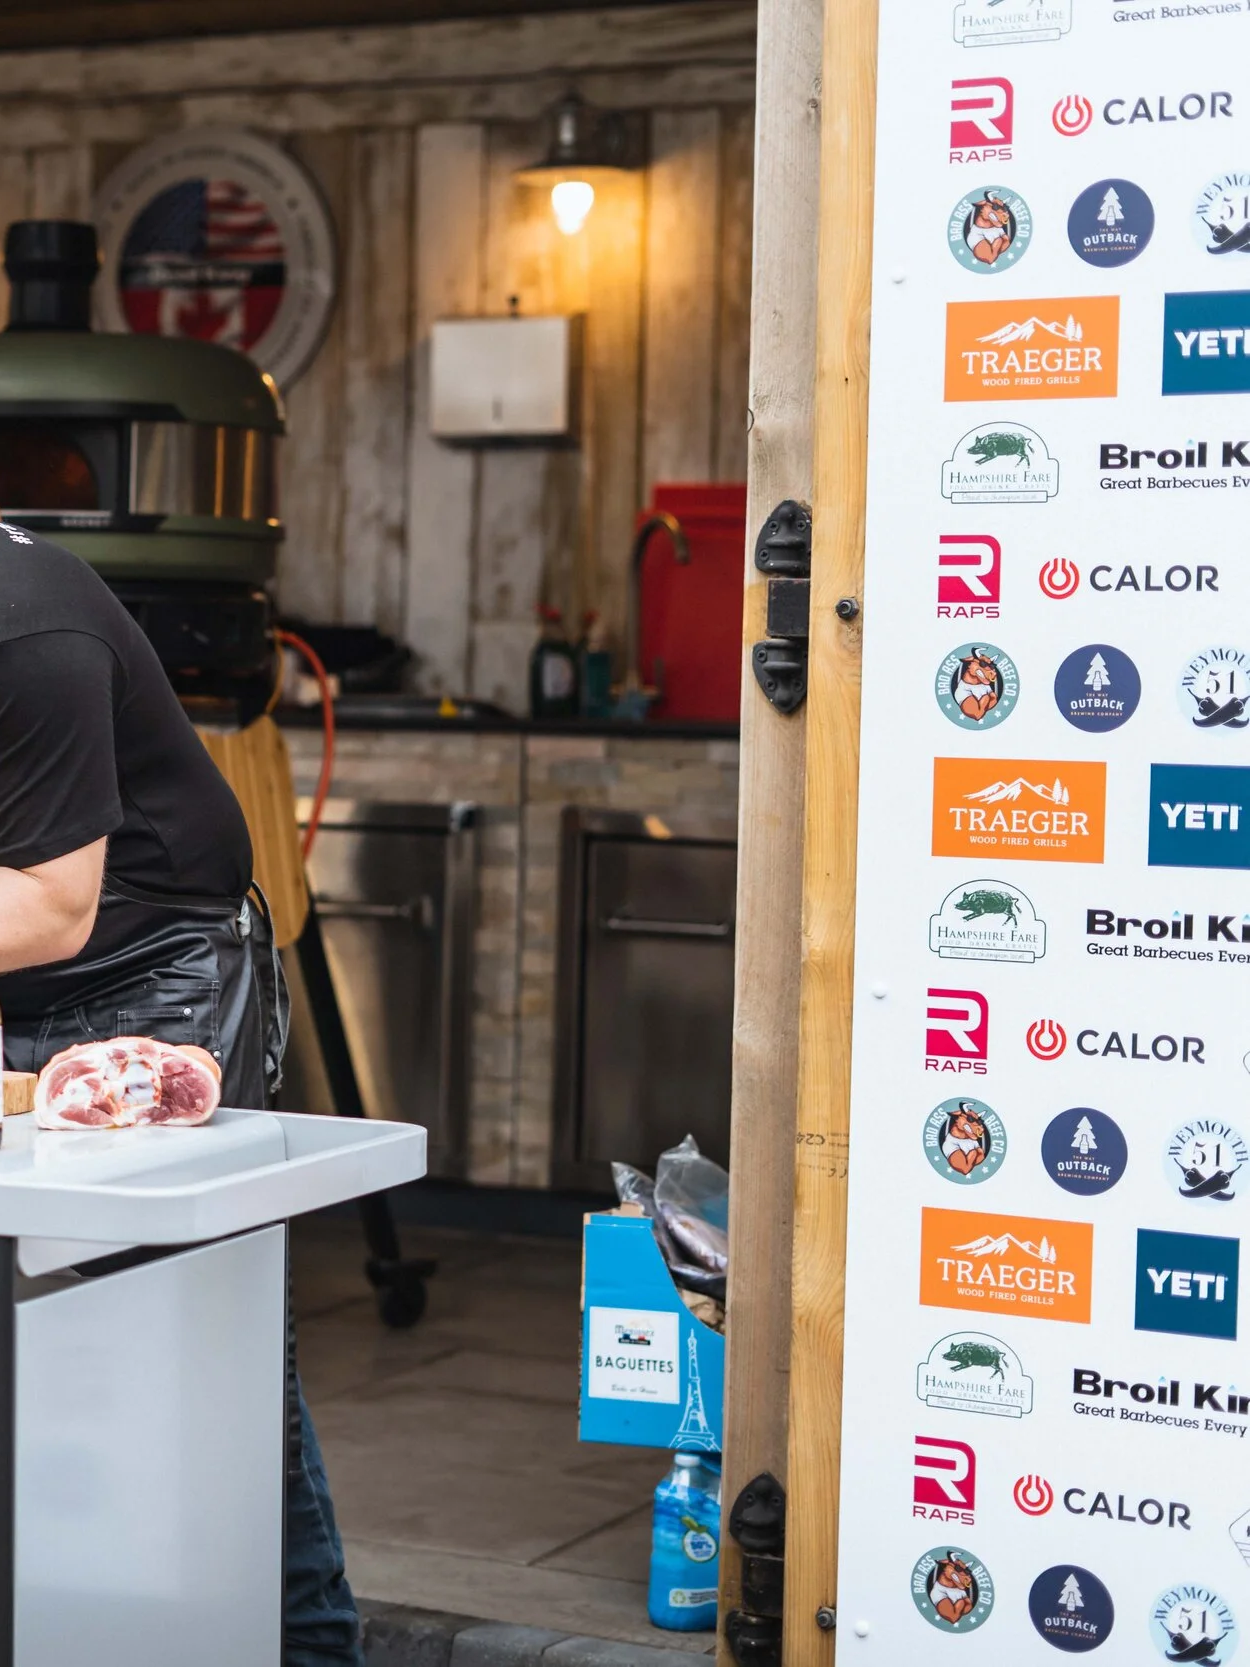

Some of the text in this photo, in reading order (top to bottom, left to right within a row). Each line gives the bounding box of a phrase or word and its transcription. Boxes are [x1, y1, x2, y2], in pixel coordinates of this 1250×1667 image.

[962, 9, 1064, 27] HAMPSHIRE FARE
[1113, 2, 1241, 22] Great Barbecues
[1103, 91, 1233, 125] CALOR
[950, 148, 1012, 164] RAPS
[1083, 232, 1138, 247] OUTBACK
[1174, 329, 1250, 357] YETI
[961, 347, 1102, 375] TRAEGER
[982, 376, 1080, 386] WOOD FIRED GRILLS
[1100, 439, 1207, 469] Broil
[950, 471, 1051, 484] HAMPSHIRE FARE
[1100, 477, 1142, 489] Great
[1147, 476, 1227, 489] Barbecues
[1089, 565, 1219, 592] CALOR
[937, 606, 1000, 618] RAPS
[937, 654, 1018, 697] BAD ASS BEEF CO
[1206, 670, 1236, 695] 51
[1070, 698, 1125, 711] OUTBACK
[949, 807, 1089, 836] TRAEGER
[1160, 802, 1240, 831] YETI
[969, 836, 1067, 847] WOOD FIRED GRILLS
[938, 926, 1039, 943] HAMPSHIRE FARE
[1086, 909, 1193, 940] Broil
[1087, 943, 1128, 957] Great
[1133, 945, 1213, 961] Barbecues
[1076, 1029, 1205, 1064] CALOR
[925, 1058, 988, 1075] RAPS
[796, 1132, 825, 1147] C24
[925, 1107, 1005, 1154] BAD ASS BEEF CO
[1168, 1120, 1249, 1162] WEYMOUTH
[1192, 1141, 1222, 1167] 51
[1057, 1161, 1111, 1175] OUTBACK
[936, 1258, 1076, 1295] TRAEGER
[1146, 1267, 1226, 1302] YETI
[957, 1287, 1054, 1305] WOOD FIRED GRILLS
[595, 1355, 674, 1373] BAGUETTES
[925, 1375, 1025, 1399] HAMPSHIRE FARE
[1073, 1368, 1180, 1406] Broil
[1073, 1402, 1248, 1438] Great Barbecues Every
[912, 1505, 975, 1526] RAPS
[1063, 1488, 1191, 1531] CALOR
[913, 1554, 992, 1605] BAD ASS BEEF CO
[1154, 1586, 1235, 1631] WEYMOUTH
[1178, 1607, 1207, 1633] 51
[1044, 1617, 1098, 1634] OUTBACK
